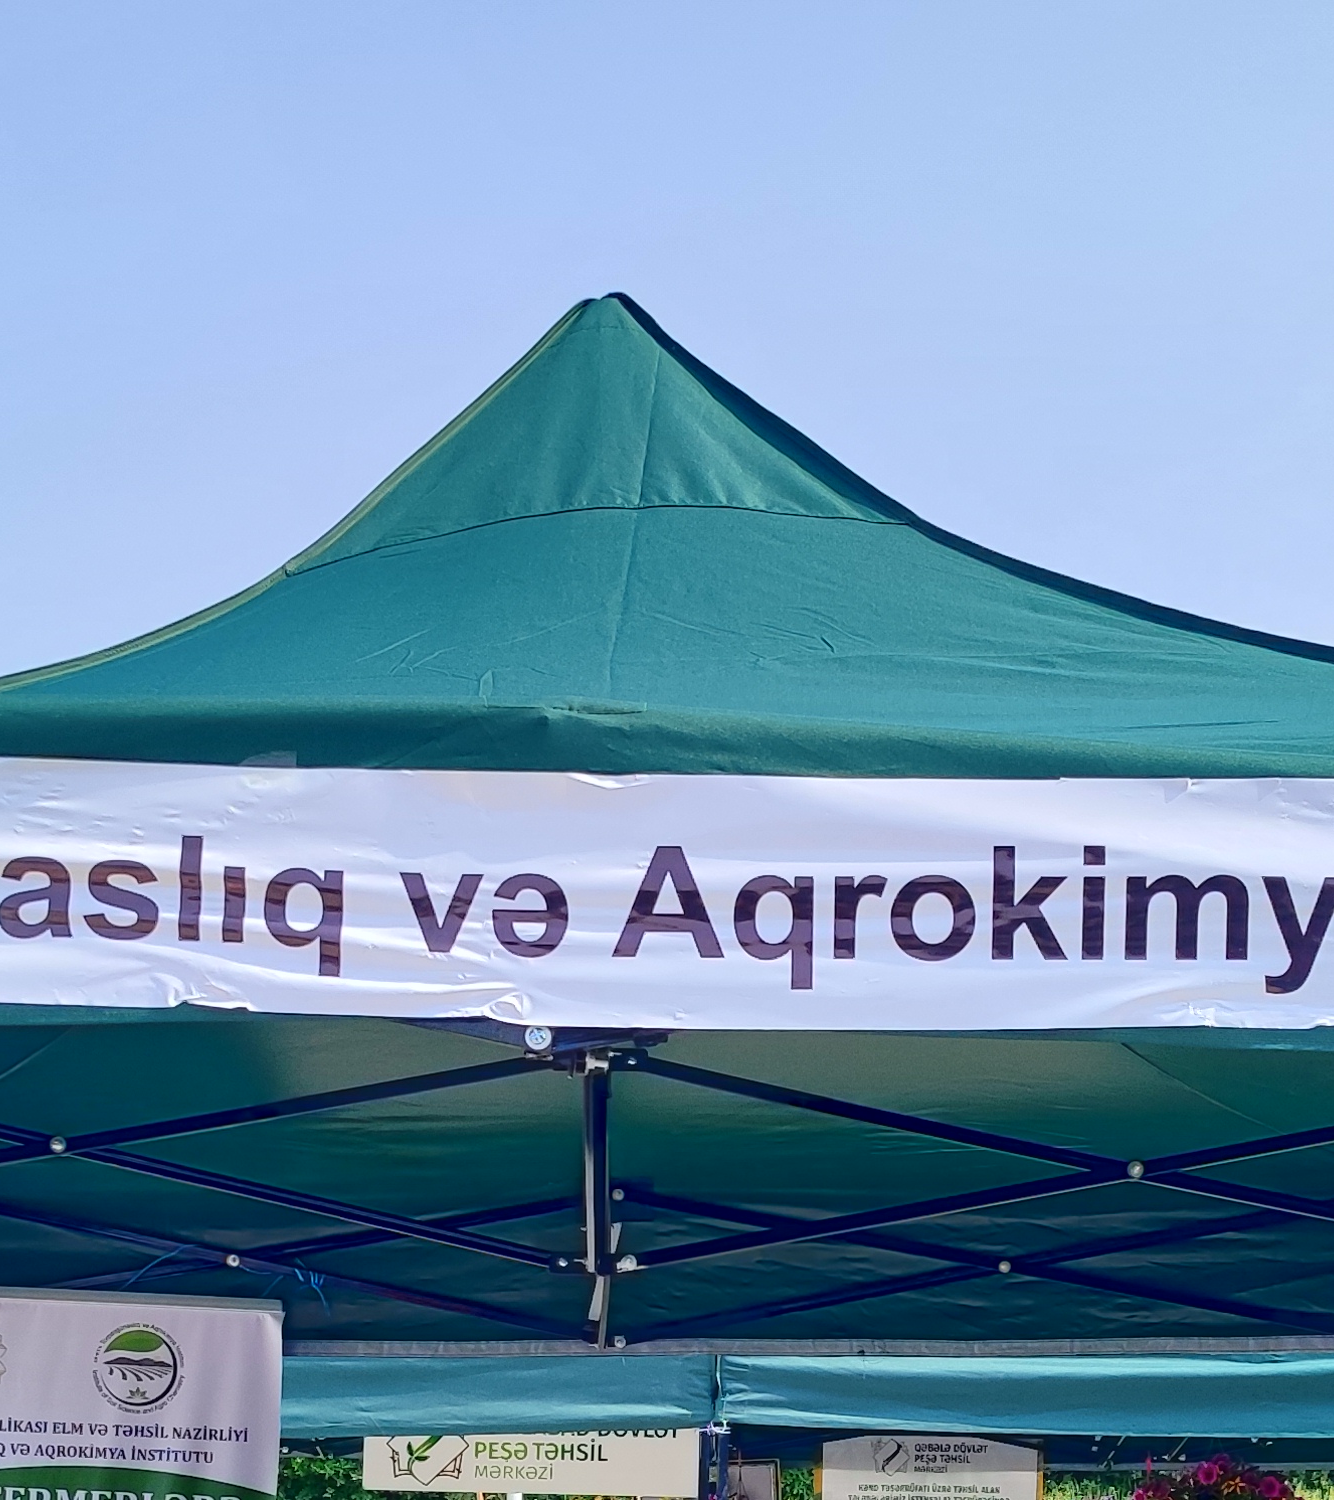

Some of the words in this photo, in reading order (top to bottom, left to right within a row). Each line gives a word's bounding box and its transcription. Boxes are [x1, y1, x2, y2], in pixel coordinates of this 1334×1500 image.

[401, 868, 568, 959] və
[52, 1423, 83, 1435] ELM
[88, 1424, 108, 1436] VƏ
[112, 1423, 168, 1439] TƏHSİL
[172, 1425, 249, 1442] NAZİRLİYİ
[10, 1443, 30, 1455] VƏ
[34, 1443, 127, 1460] AQROKİMYA
[131, 1446, 214, 1464] İNSTİTUTU
[474, 1441, 528, 1463] PEŞƏ
[534, 1438, 609, 1462] TƏHSİL
[914, 1454, 937, 1466] PEŞƏ
[474, 1462, 554, 1481] MƏRKƏZİ
